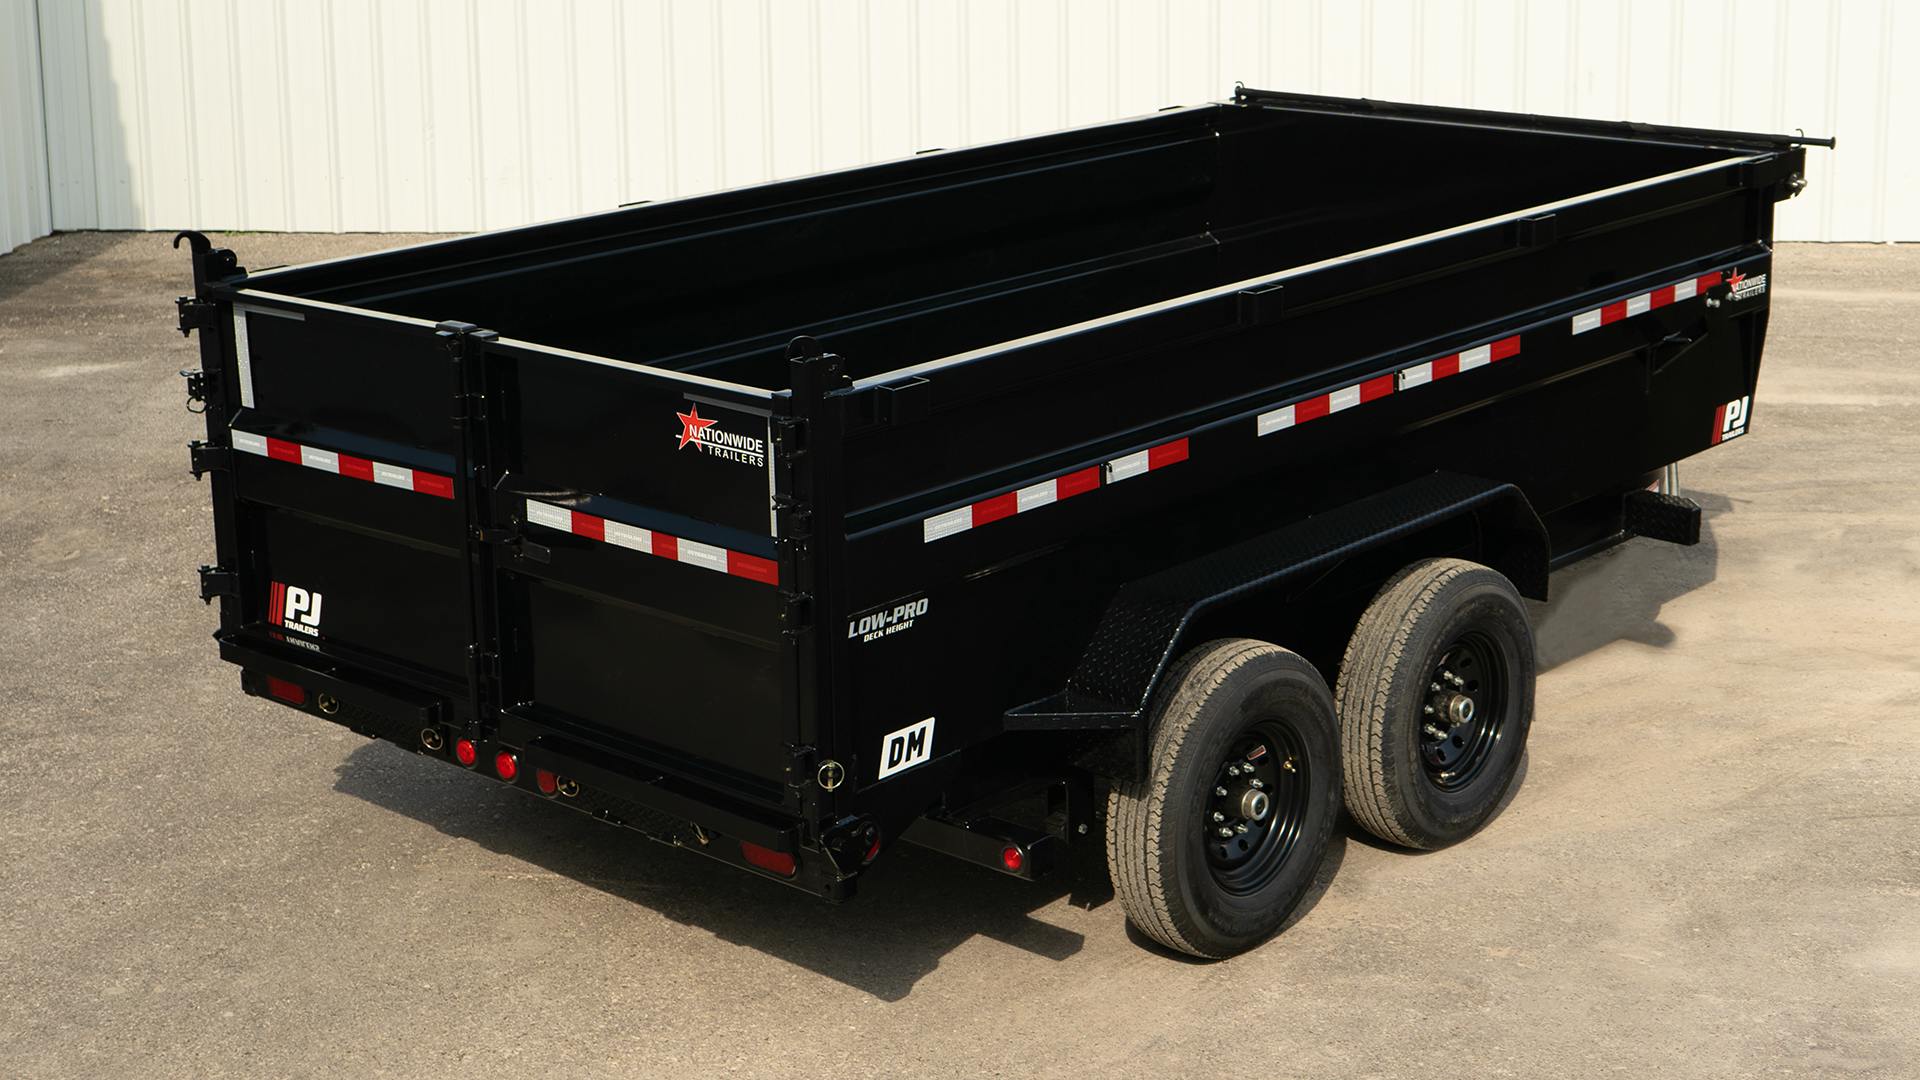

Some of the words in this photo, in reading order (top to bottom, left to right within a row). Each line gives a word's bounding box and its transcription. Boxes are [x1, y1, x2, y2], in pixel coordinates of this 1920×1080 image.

[1723, 395, 1749, 433] PJ
[689, 424, 764, 453] NATIONWIDE
[708, 445, 764, 467] TRAILERS
[285, 585, 322, 627] PJ
[848, 598, 929, 638] LOW-PRO
[284, 619, 319, 637] TRAILERS
[863, 629, 884, 642] DECK
[885, 619, 914, 635] HEIGHT
[888, 726, 927, 769] DM
